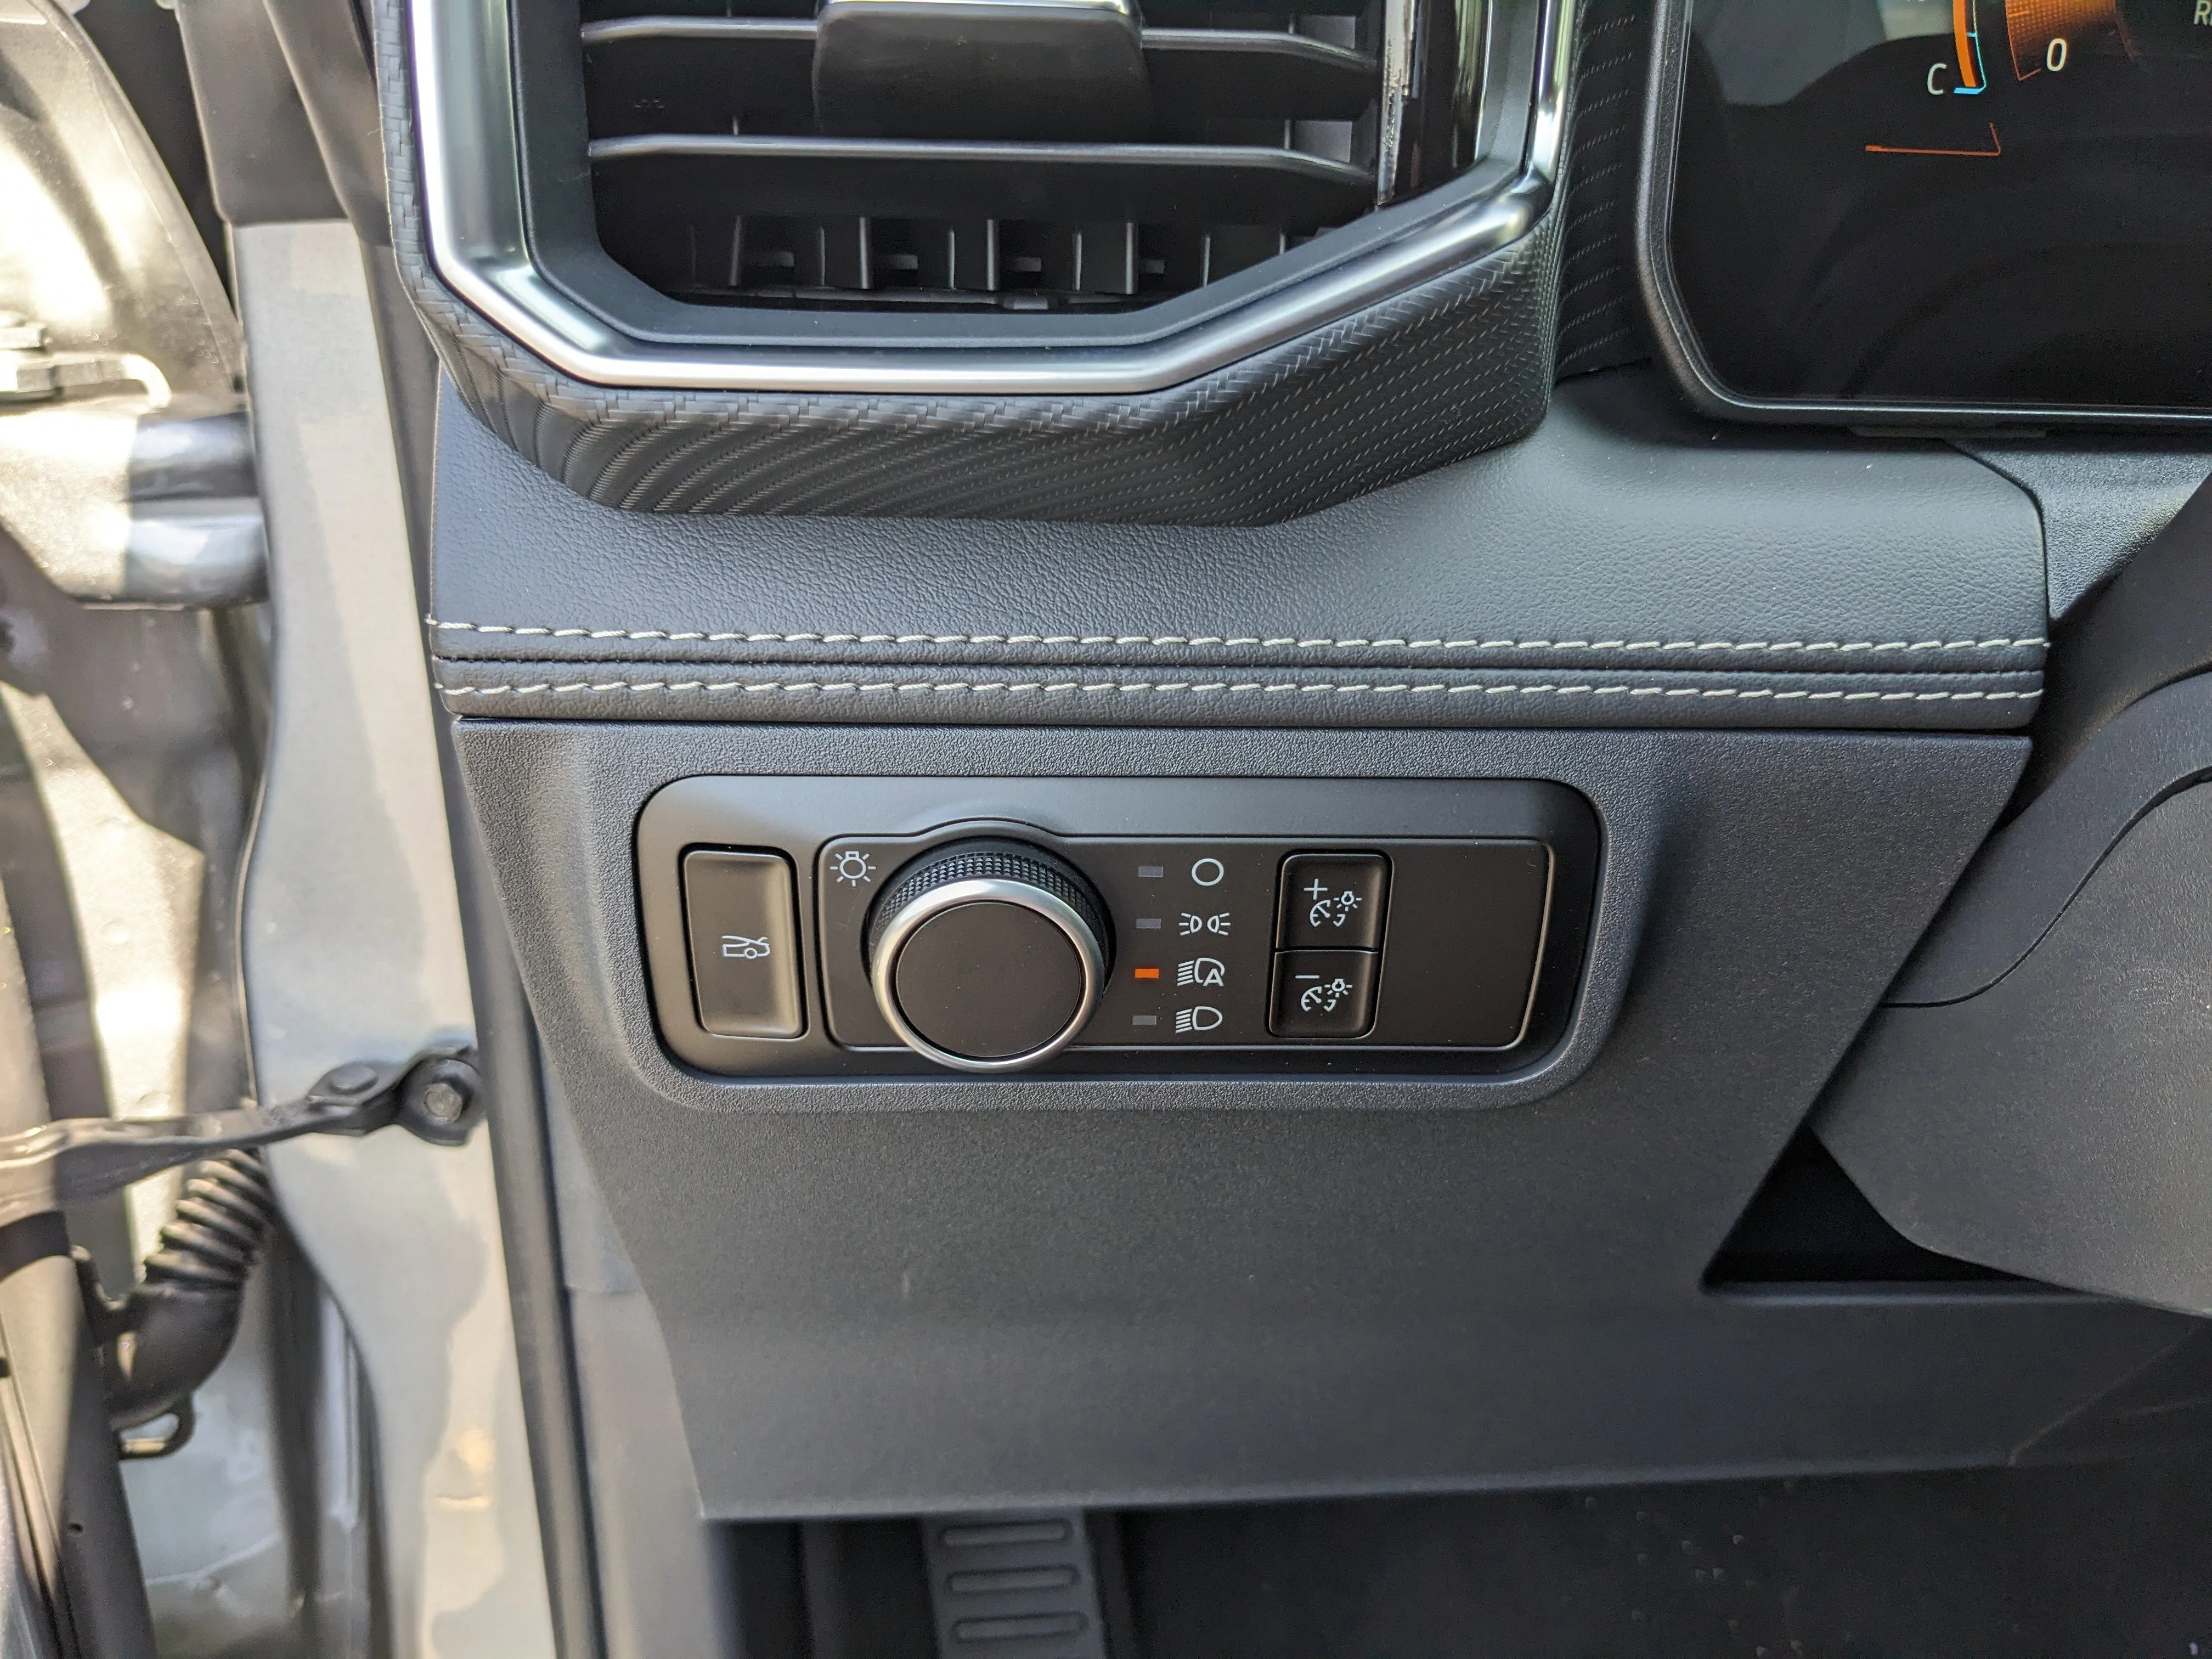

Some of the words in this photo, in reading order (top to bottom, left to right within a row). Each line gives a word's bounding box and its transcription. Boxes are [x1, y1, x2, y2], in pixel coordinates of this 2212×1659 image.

[2193, 0, 2212, 26] R
[2046, 38, 2067, 71] 0
[1927, 63, 1947, 95] C
[1203, 968, 1224, 986] A
